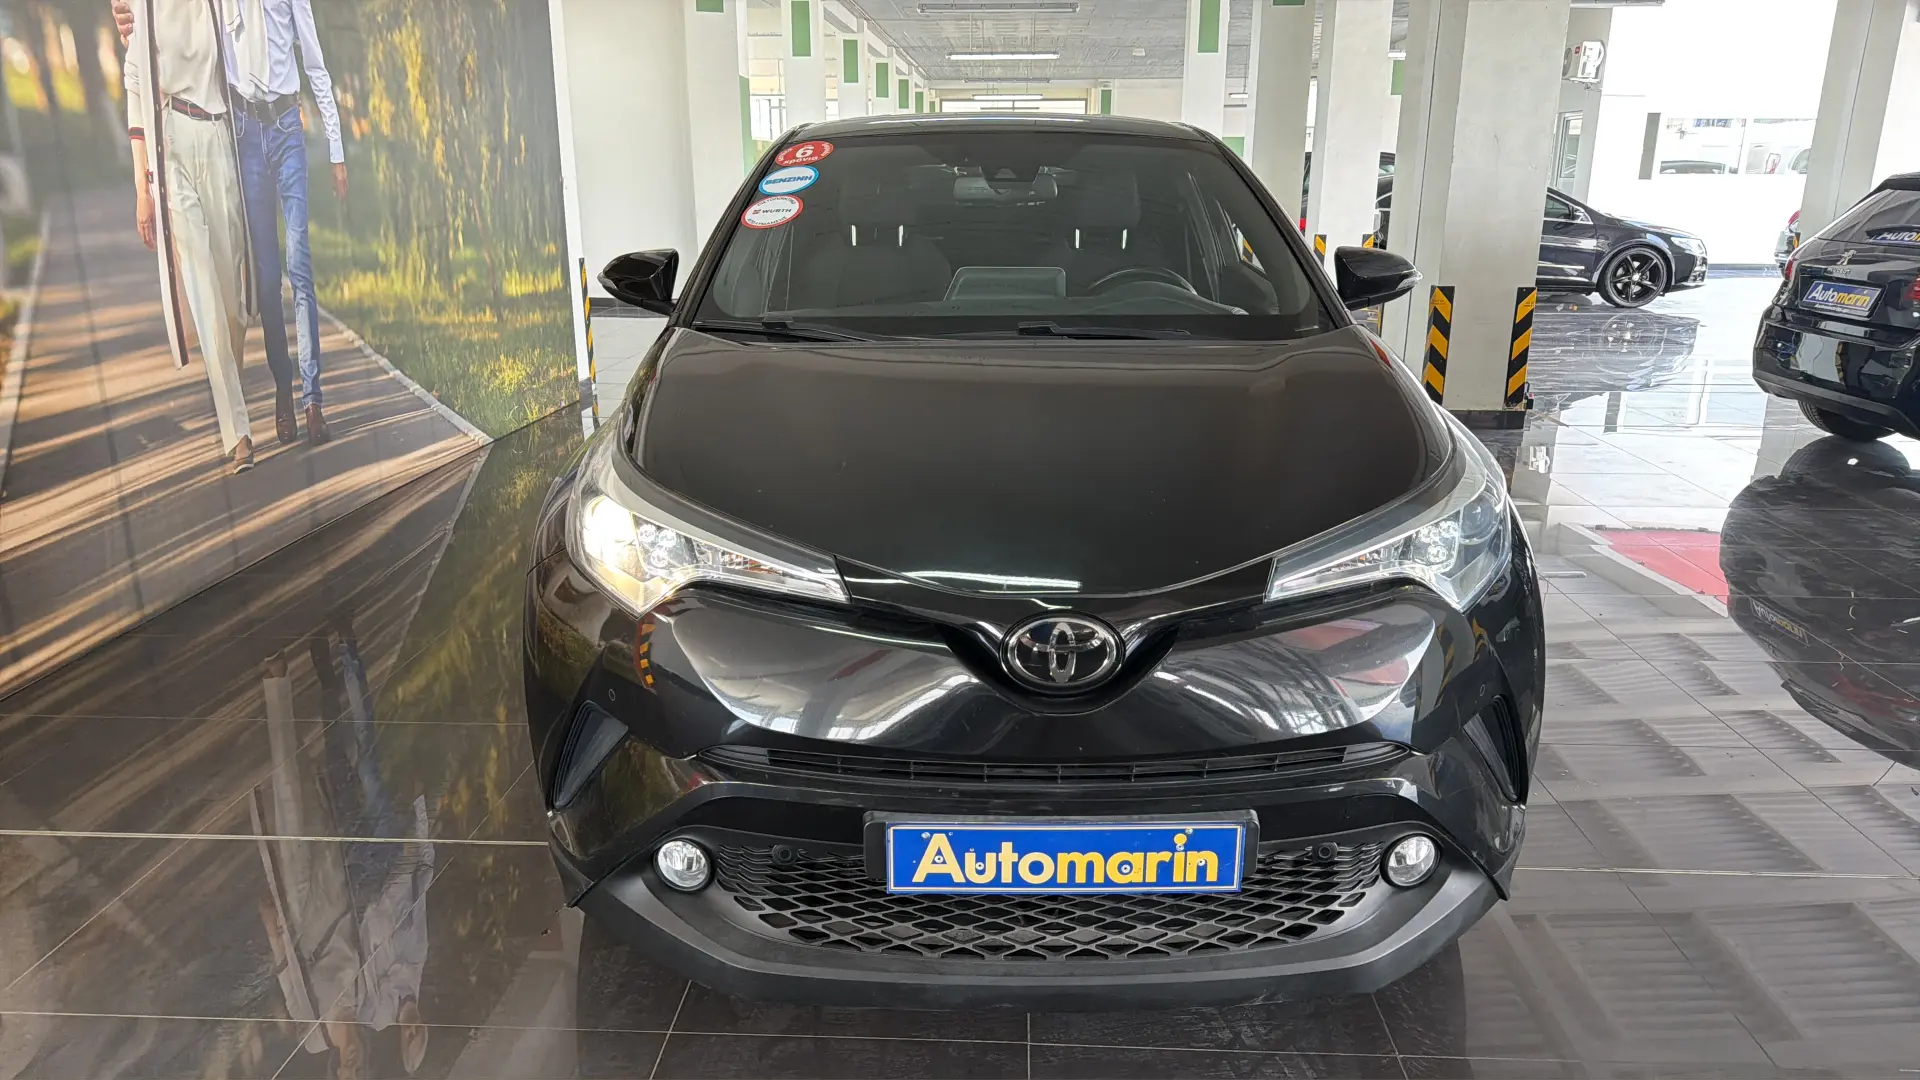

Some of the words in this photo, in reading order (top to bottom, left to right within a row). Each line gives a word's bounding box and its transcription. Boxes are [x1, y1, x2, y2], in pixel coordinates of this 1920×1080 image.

[796, 144, 815, 158] 6
[1808, 283, 1870, 307] Automarin
[912, 832, 1218, 884] Automarin
